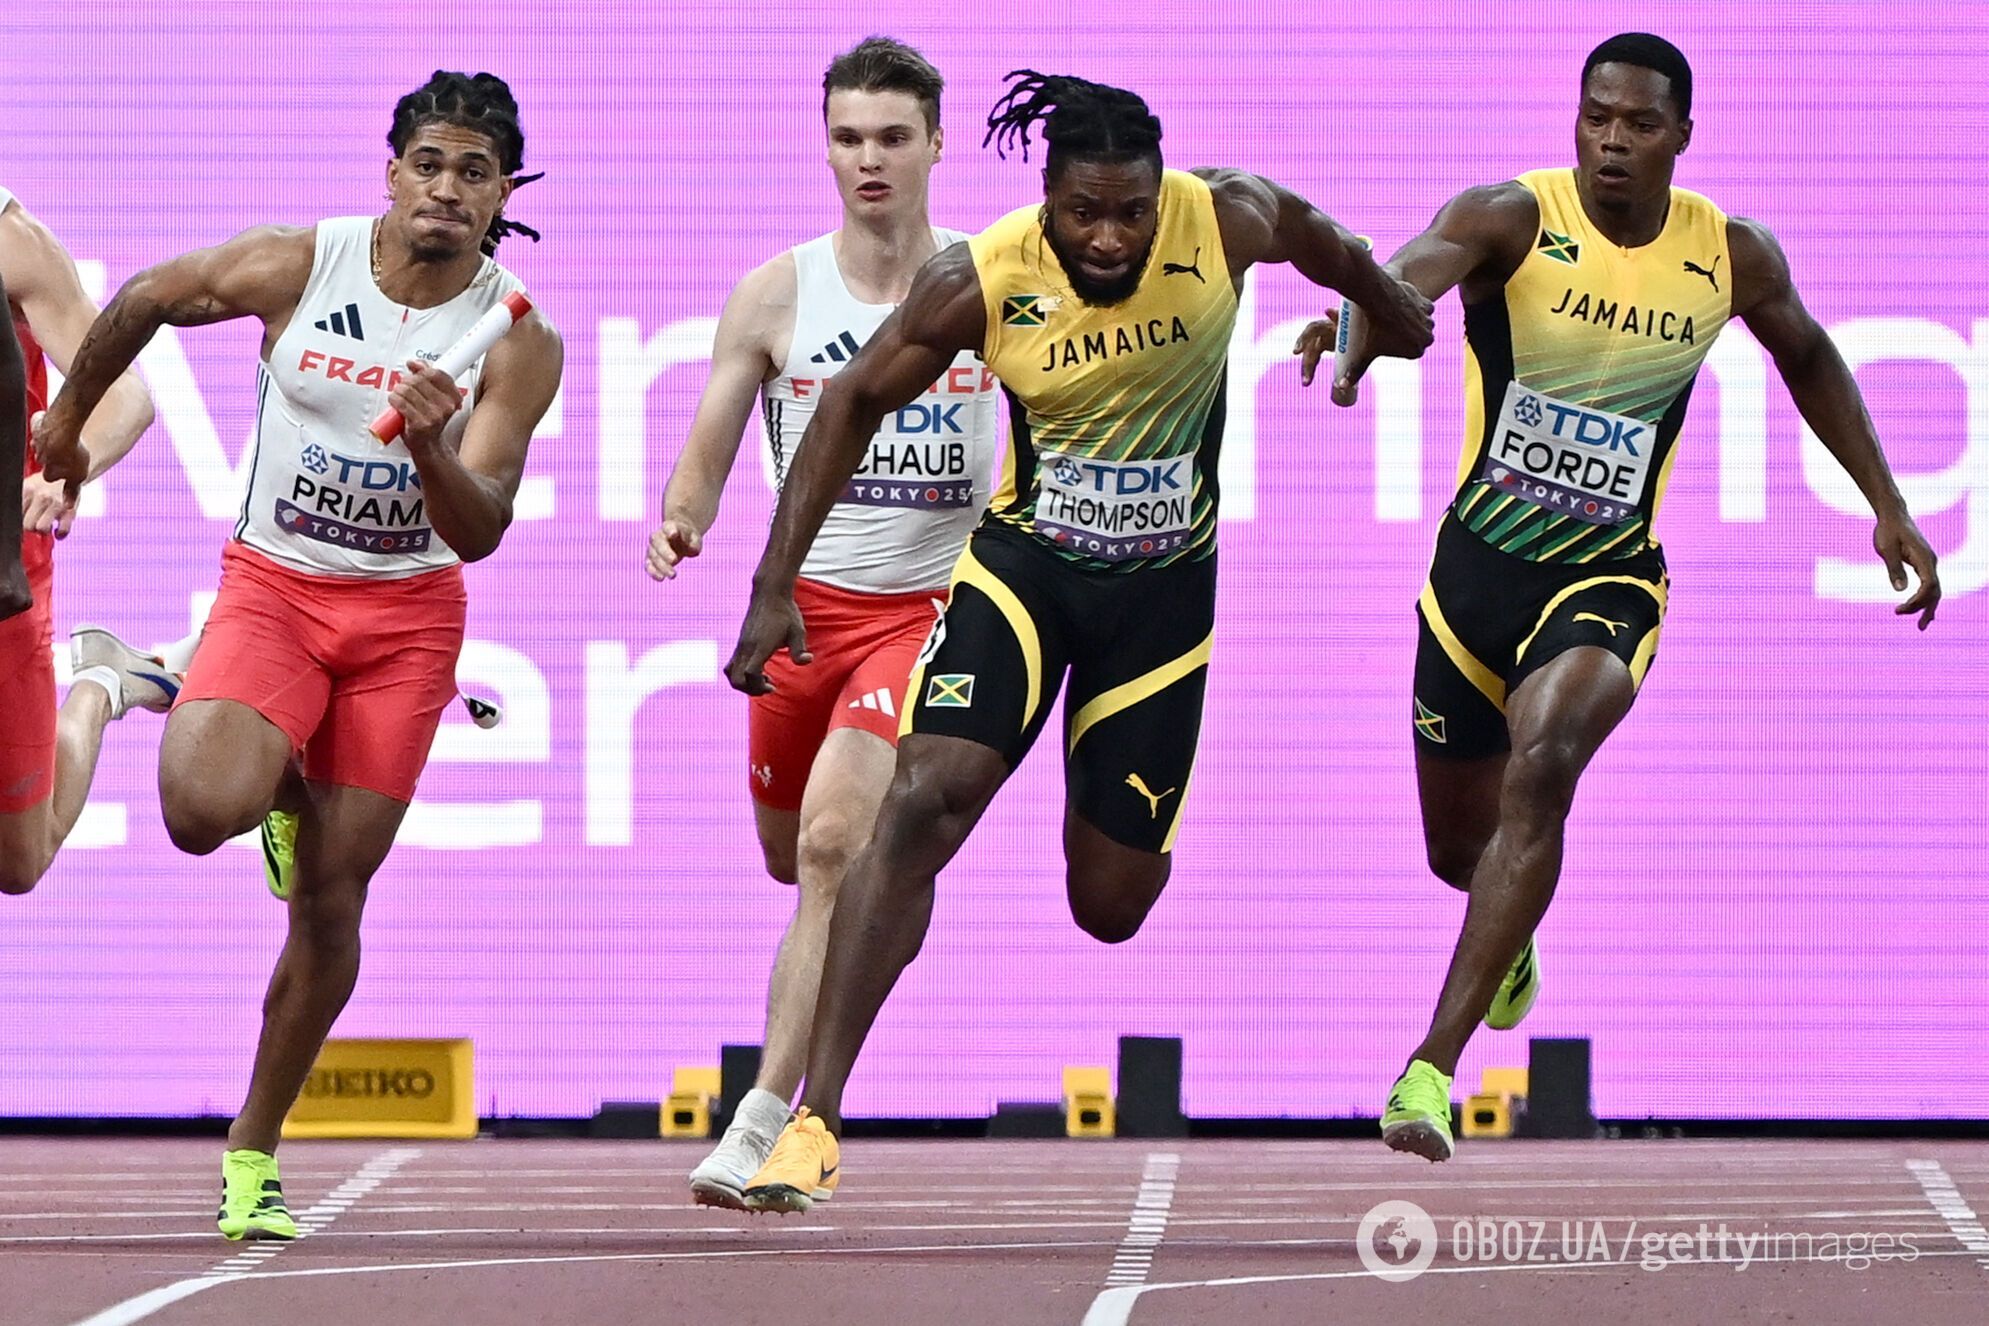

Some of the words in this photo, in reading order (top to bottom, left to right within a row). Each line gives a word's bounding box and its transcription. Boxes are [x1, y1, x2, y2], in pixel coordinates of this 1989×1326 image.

[1551, 288, 1695, 345] JAMAICA
[1042, 316, 1190, 372] JAMAICA
[876, 403, 963, 434] DK
[1546, 403, 1646, 457] TDK
[331, 453, 422, 492] TDK
[1082, 461, 1182, 495] TDK
[1500, 430, 1636, 499] FORDE
[292, 474, 423, 527] PRIAM
[1047, 488, 1186, 533] THOMPSON
